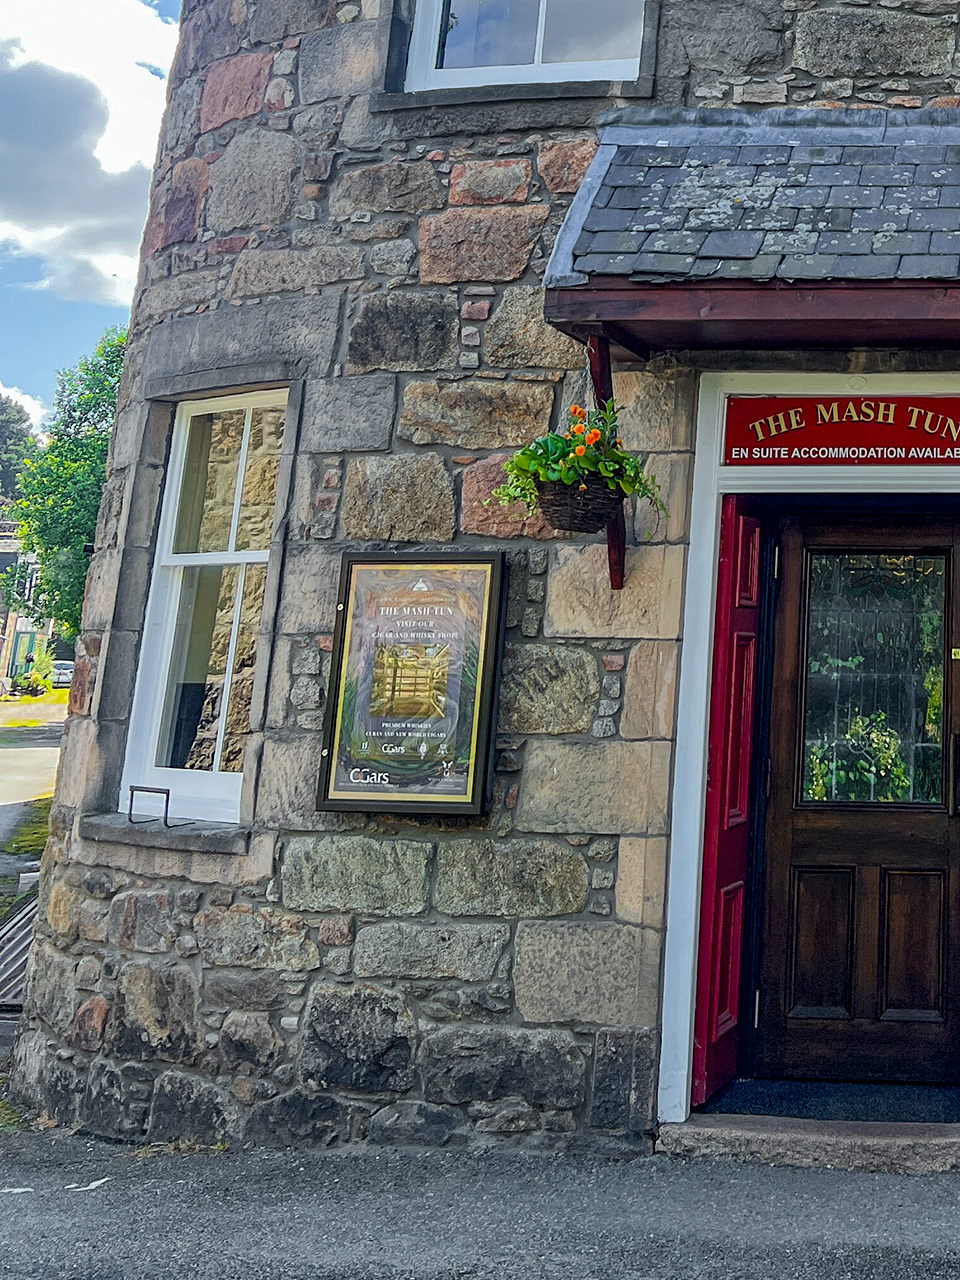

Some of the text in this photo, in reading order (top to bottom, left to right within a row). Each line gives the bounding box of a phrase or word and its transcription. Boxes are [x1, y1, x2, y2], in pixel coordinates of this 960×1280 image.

[748, 407, 806, 444] THE
[815, 401, 898, 426] MASH
[731, 447, 749, 459] EN
[751, 447, 789, 459] SUITE
[792, 447, 906, 459] ACCOMMODATION
[379, 606, 454, 616] THE MASH TUN
